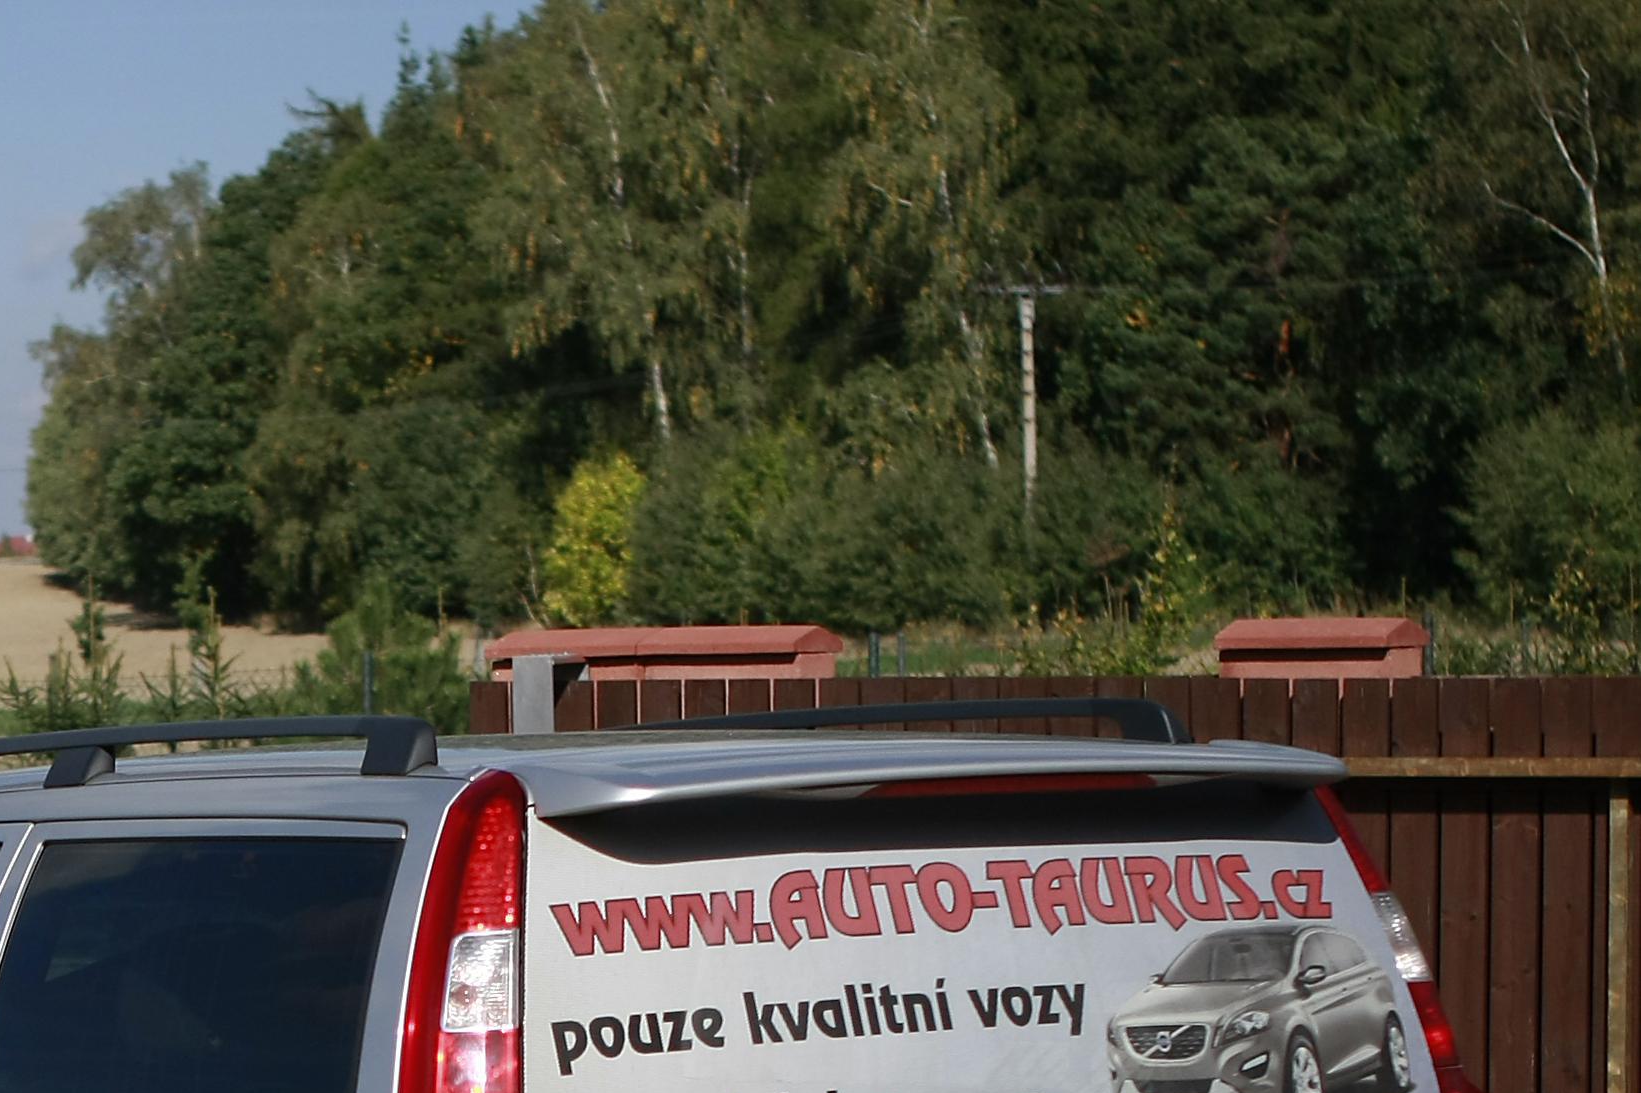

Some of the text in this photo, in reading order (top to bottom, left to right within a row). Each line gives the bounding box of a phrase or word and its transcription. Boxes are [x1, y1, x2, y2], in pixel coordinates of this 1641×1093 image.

[550, 854, 1333, 956] www.AUTO-TAURUS.cz
[551, 977, 1087, 1076] pouze kvalitní vozy
